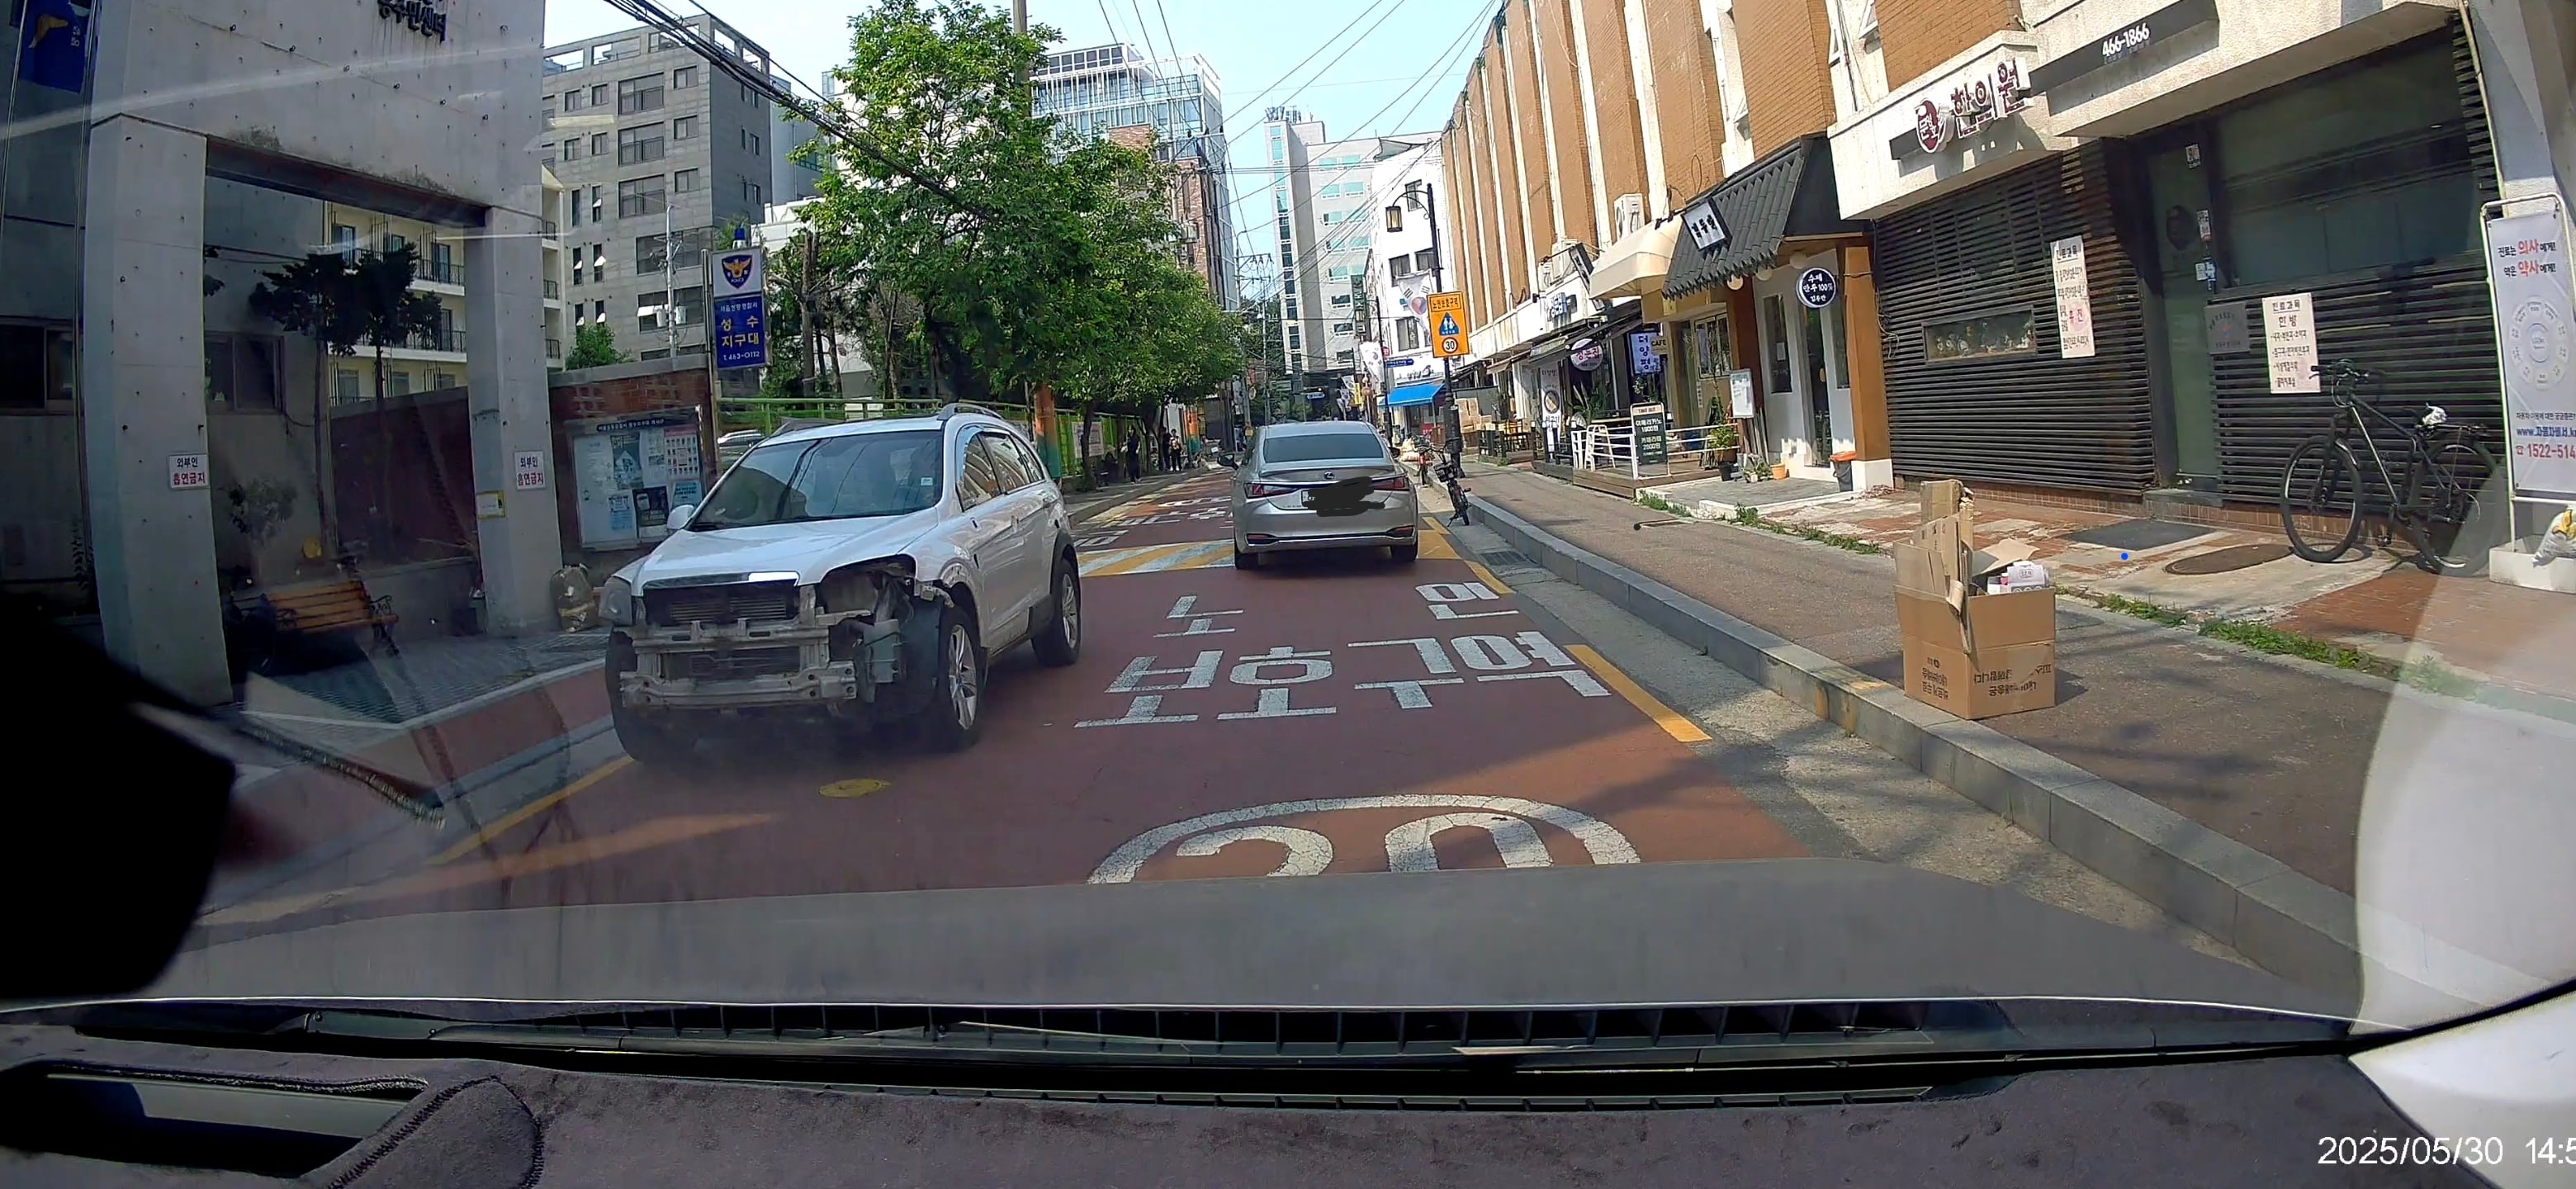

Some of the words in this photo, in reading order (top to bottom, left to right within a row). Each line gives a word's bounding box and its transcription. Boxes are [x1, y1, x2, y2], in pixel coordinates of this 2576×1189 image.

[2102, 22, 2150, 56] 466-1866
[1950, 57, 2025, 140] 한의원
[2498, 246, 2516, 258] 진료는
[721, 318, 732, 331] 성
[746, 315, 759, 328] 수
[722, 333, 759, 348] 지구대
[1446, 341, 1455, 350] 30
[177, 457, 198, 468] 외부인
[520, 457, 538, 468] 외부인
[173, 471, 206, 486] 흡연금지
[517, 472, 543, 486] 흡연금지
[1153, 595, 1243, 637] 노
[1415, 582, 1519, 620] 인
[1074, 631, 1612, 728] 보호구역
